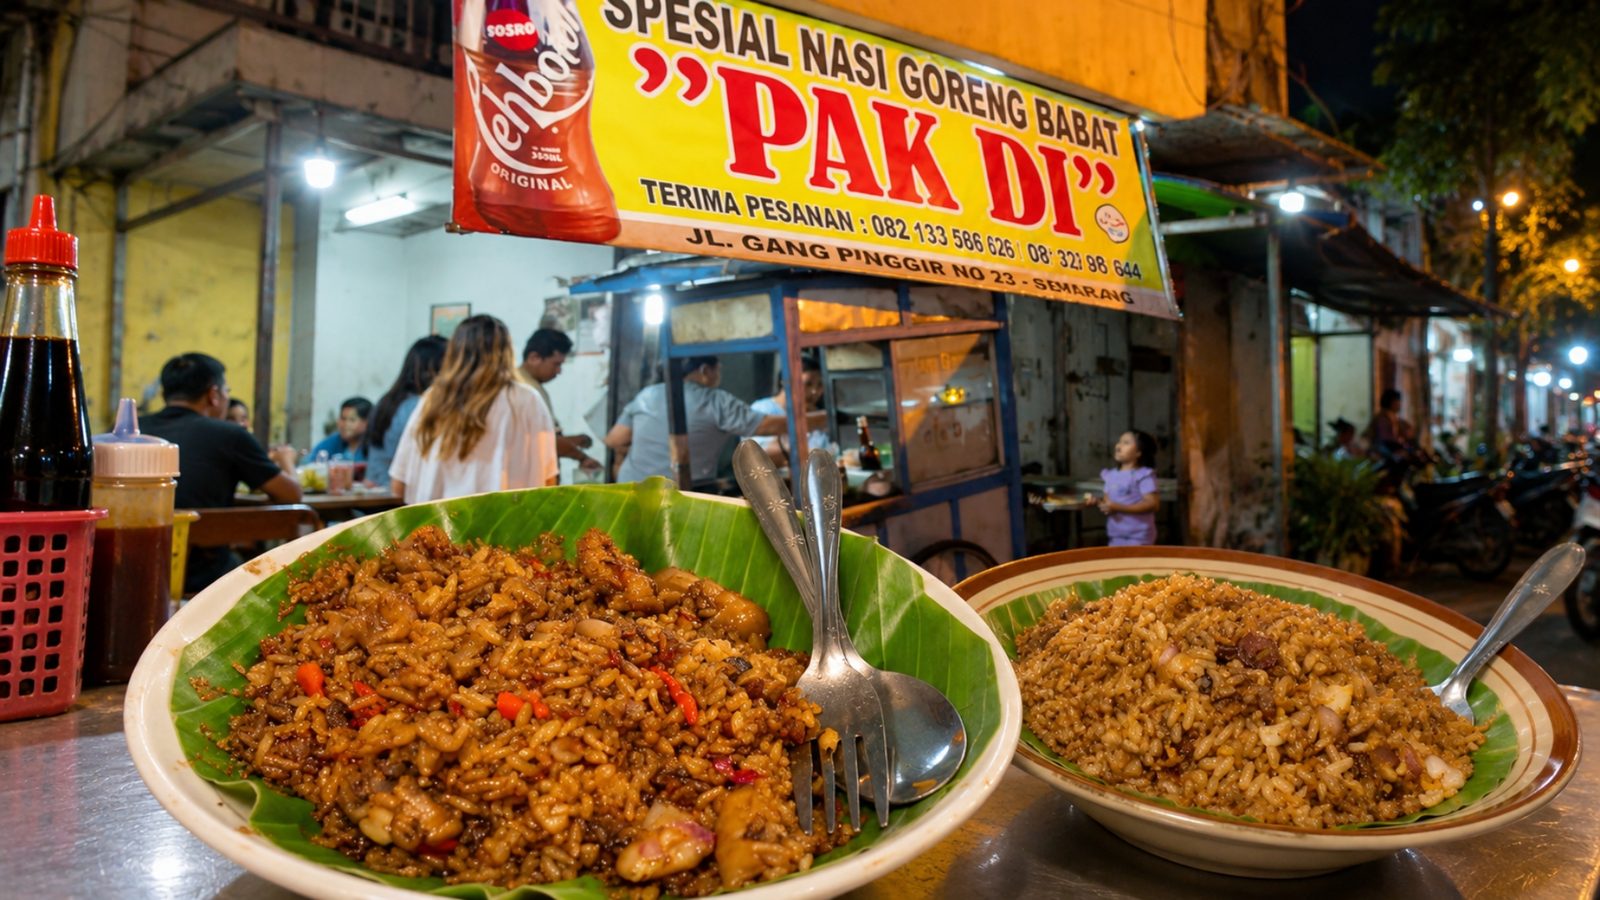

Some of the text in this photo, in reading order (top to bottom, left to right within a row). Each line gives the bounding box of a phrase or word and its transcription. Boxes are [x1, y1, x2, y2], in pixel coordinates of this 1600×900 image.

[487, 22, 535, 37] SOSRO
[604, 0, 1118, 156] SPESIAL NASI GORENG BABAT
[490, 162, 572, 191] ORIGINAL
[640, 179, 741, 216] TERIMA
[746, 194, 854, 233] PESANAN
[872, 215, 910, 241] 082
[914, 222, 948, 246] 133
[952, 228, 984, 253] 586
[987, 235, 1015, 259] 626
[1113, 259, 1142, 280] 644
[686, 228, 734, 248] JL.
[742, 235, 830, 259] GANG
[836, 247, 946, 275] PINGGIR
[952, 264, 986, 281] NO
[990, 270, 1017, 286] 23
